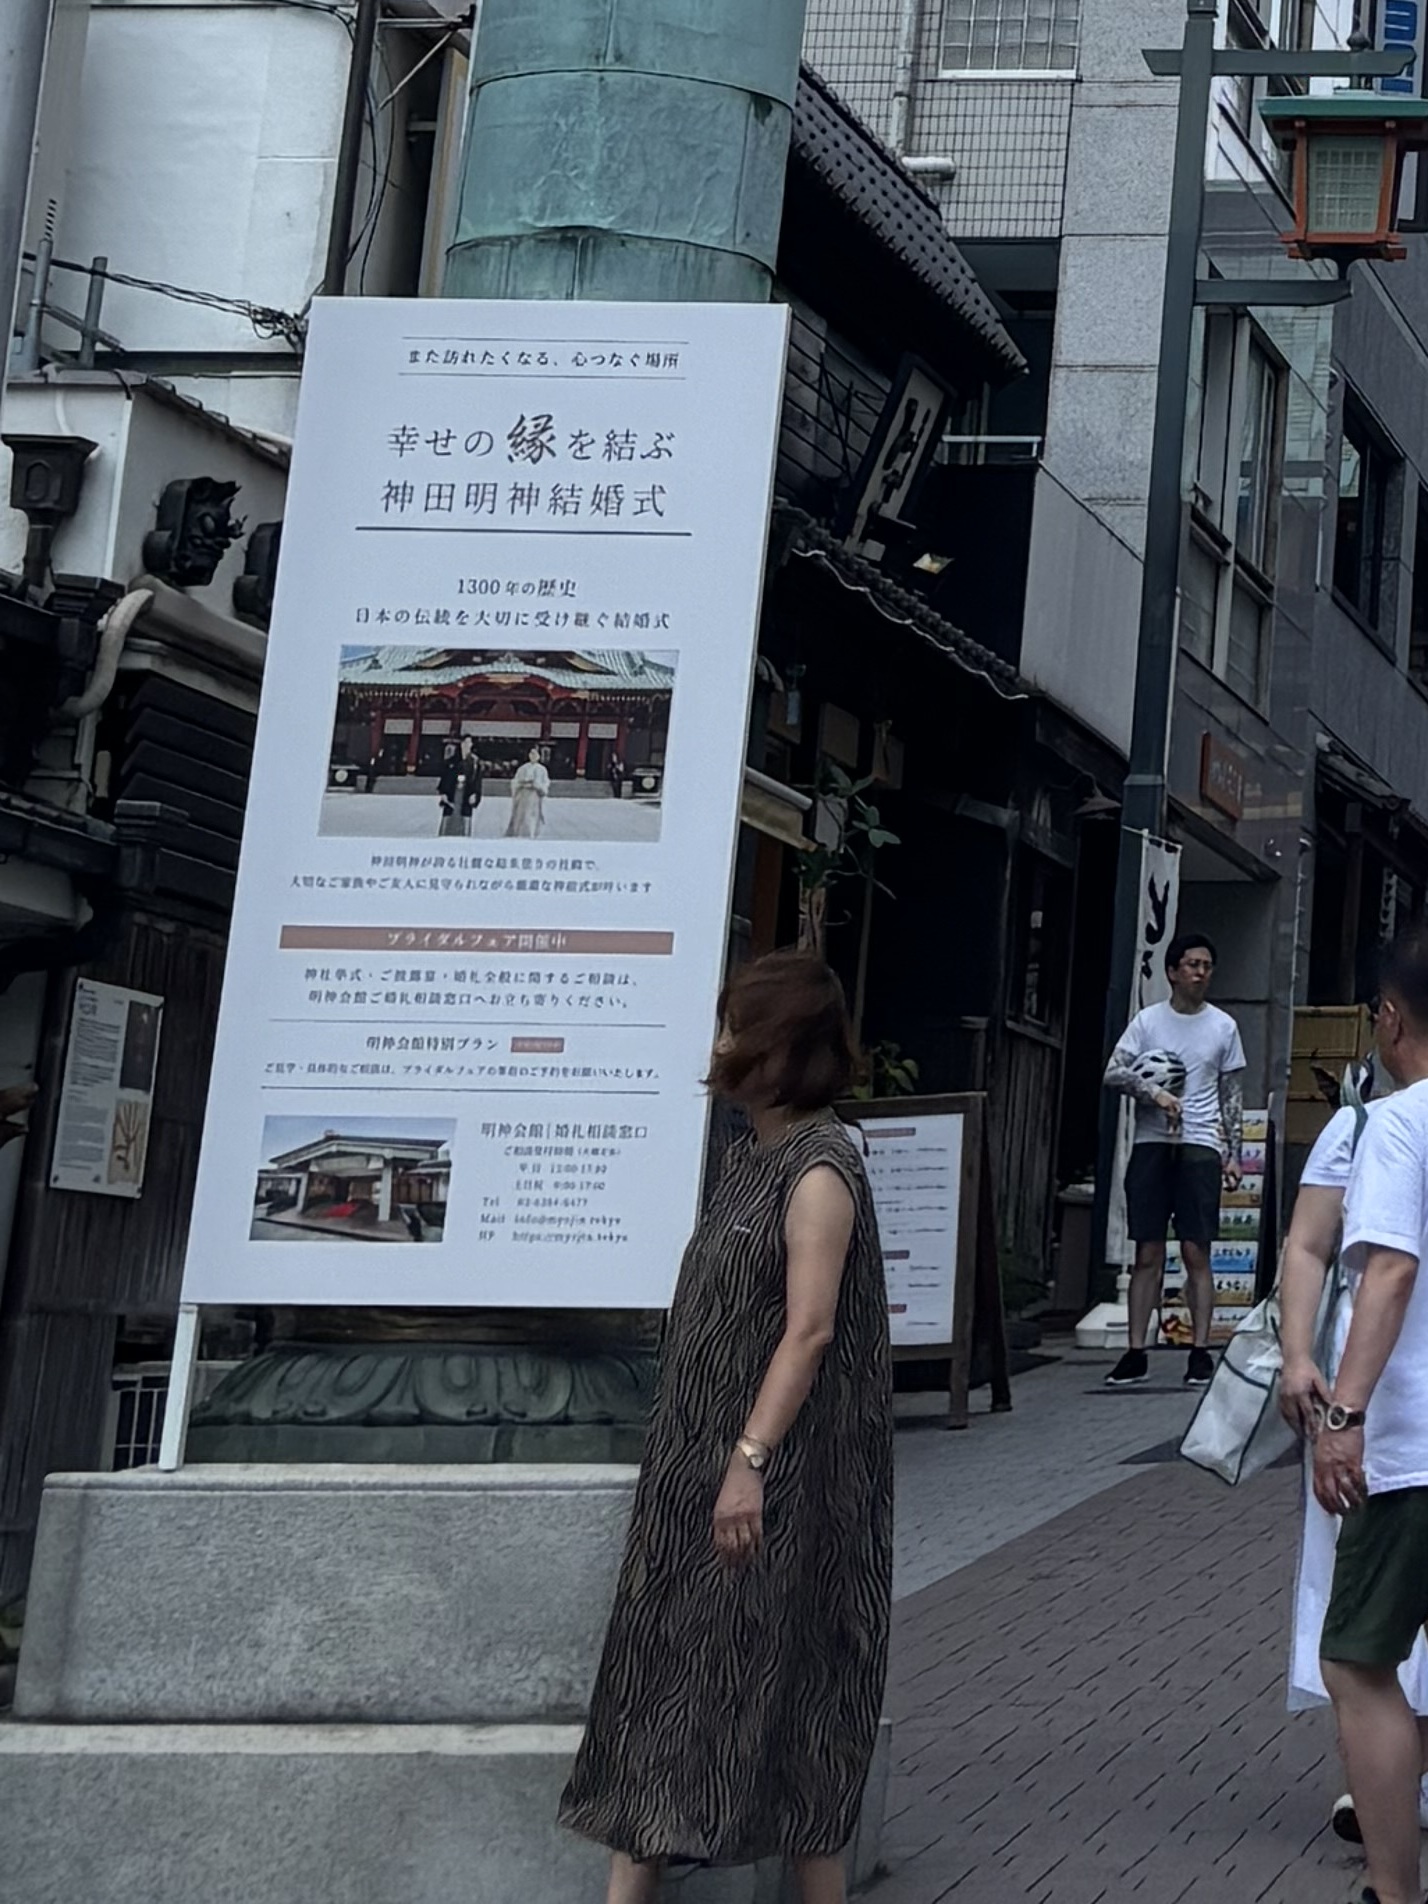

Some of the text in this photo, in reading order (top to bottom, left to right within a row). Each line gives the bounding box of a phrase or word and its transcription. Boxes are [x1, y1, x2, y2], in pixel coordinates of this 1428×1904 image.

[408, 349, 680, 371] また訪れたくなる、心つなぐ場所
[387, 413, 676, 465] 幸せの縁を結ぶ
[381, 480, 667, 519] 神田明神結婚式
